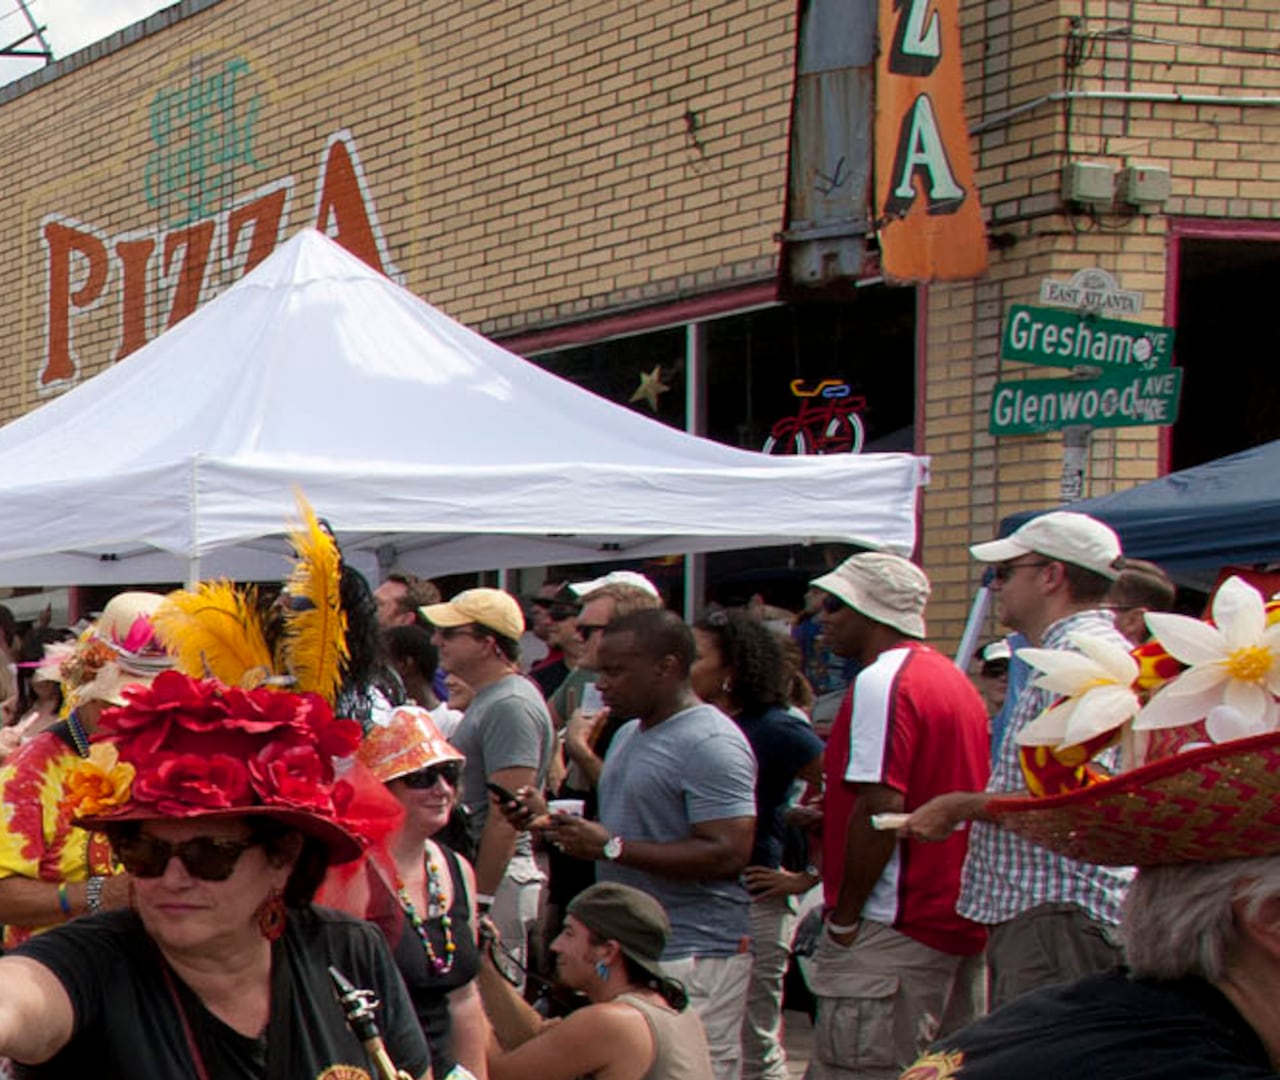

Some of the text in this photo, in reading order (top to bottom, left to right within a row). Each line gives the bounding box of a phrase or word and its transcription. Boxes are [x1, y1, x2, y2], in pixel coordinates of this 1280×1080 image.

[39, 132, 404, 390] PIZZA
[1048, 283, 1135, 312] EAST ATLANTA
[1010, 311, 1136, 364] Gresham
[994, 377, 1142, 426] Glenwood
[1142, 373, 1176, 397] AVE
